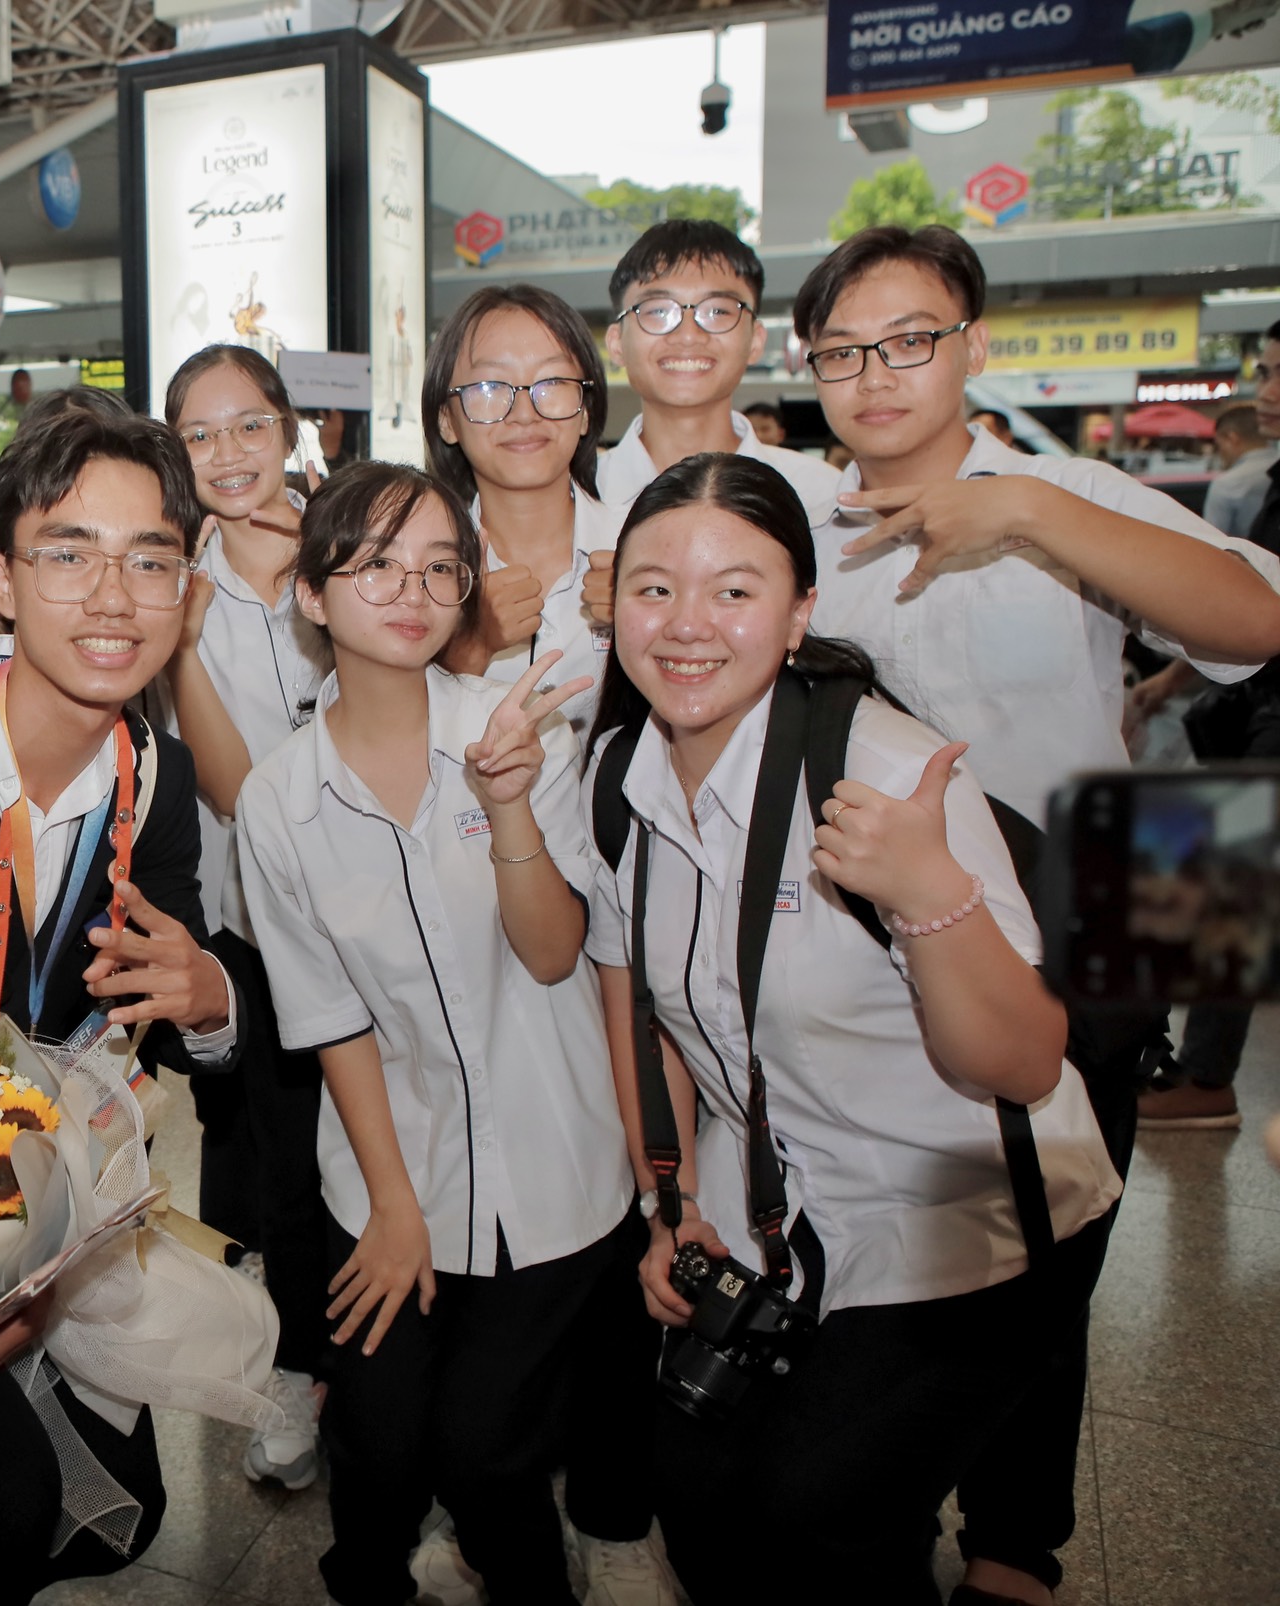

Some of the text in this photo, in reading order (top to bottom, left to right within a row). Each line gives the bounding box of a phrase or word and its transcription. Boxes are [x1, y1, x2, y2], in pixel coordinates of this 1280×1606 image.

[850, 2, 1073, 49] MỜI QUẢNG CÁO
[202, 147, 269, 176] Legend
[231, 221, 242, 238] 3
[1050, 333, 1084, 354] 39
[1095, 331, 1130, 351] 89
[1142, 329, 1176, 350] 89
[1137, 383, 1237, 402] HIGHLA
[465, 826, 480, 835] MINH
